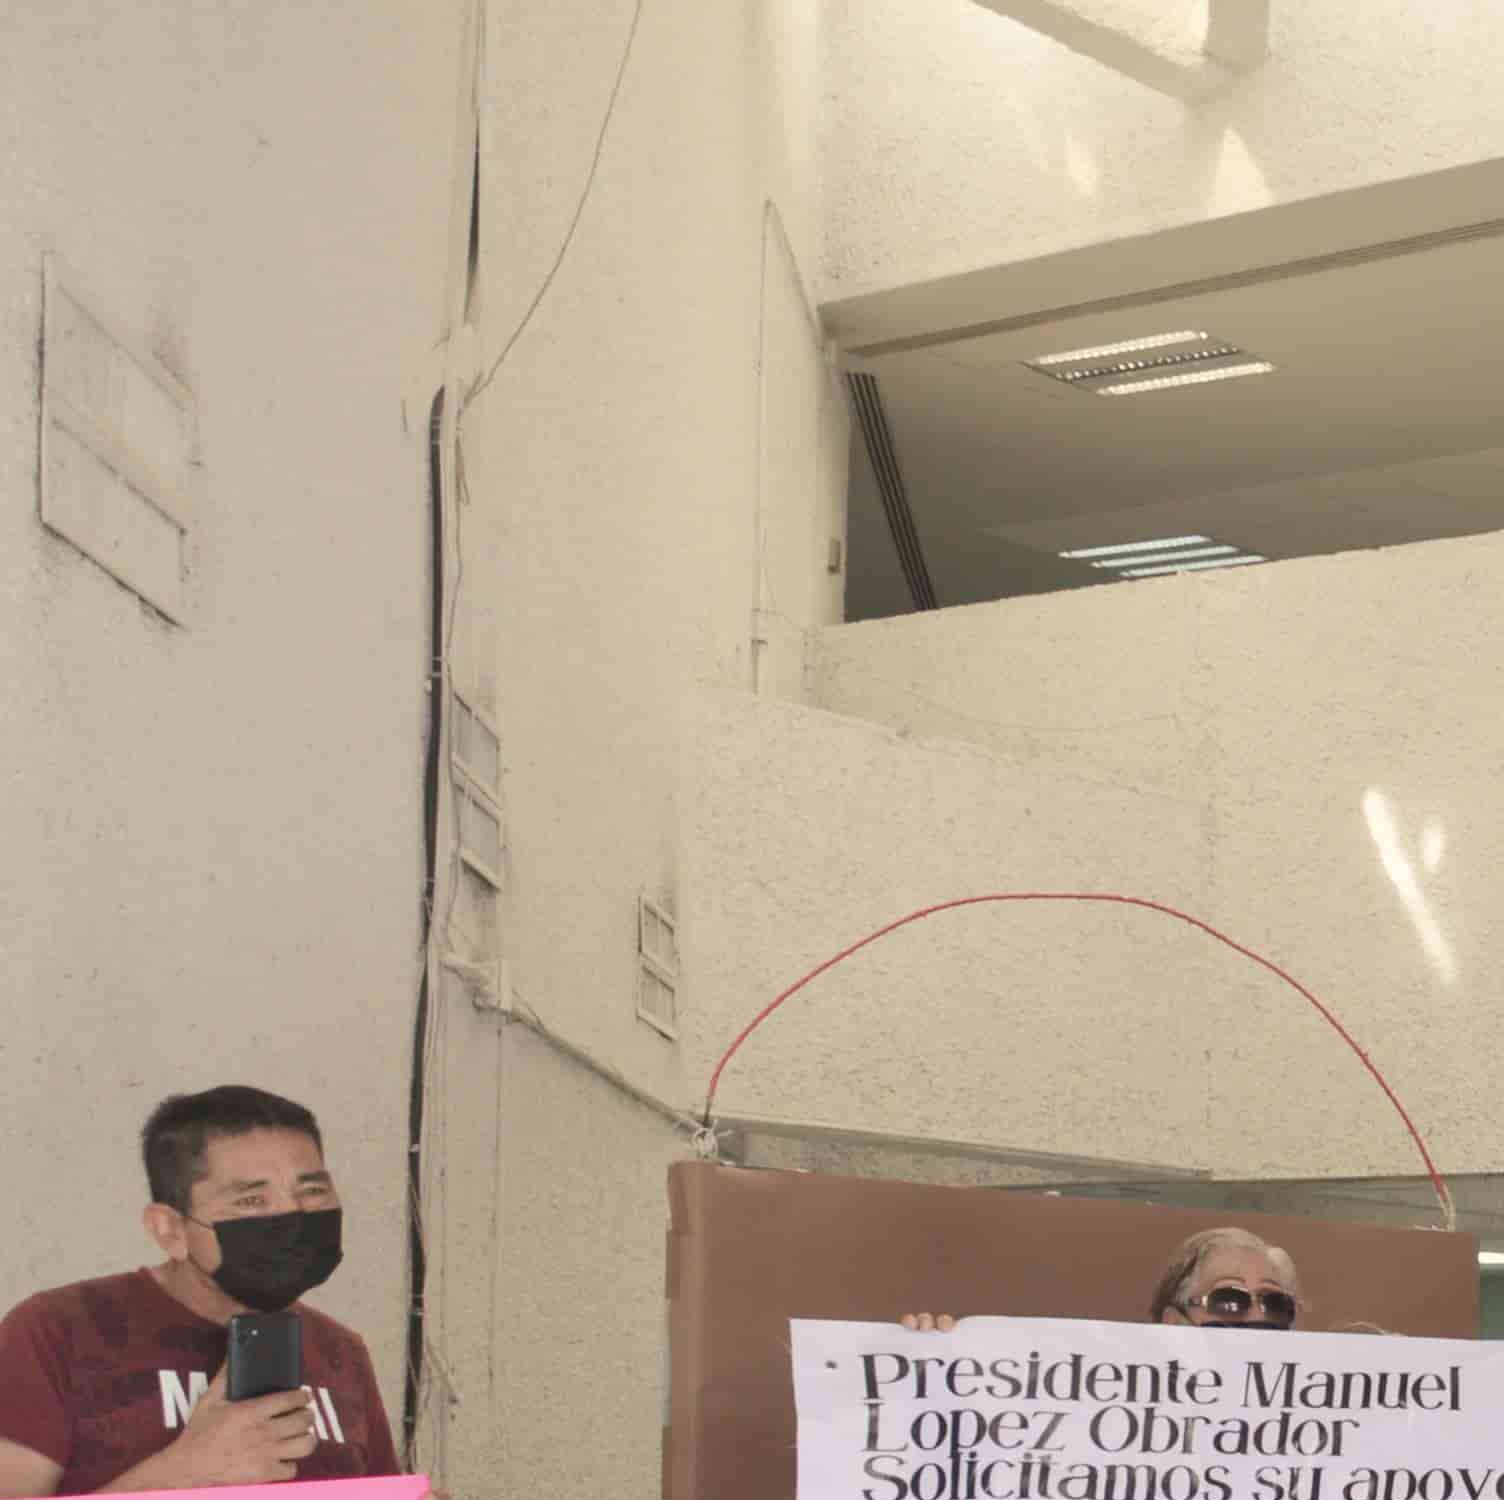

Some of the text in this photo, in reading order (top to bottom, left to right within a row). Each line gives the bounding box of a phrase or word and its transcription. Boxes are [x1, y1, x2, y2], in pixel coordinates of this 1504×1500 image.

[858, 1350, 1462, 1411] Presidente Manuel
[862, 1402, 1361, 1458] Lopez Obrador
